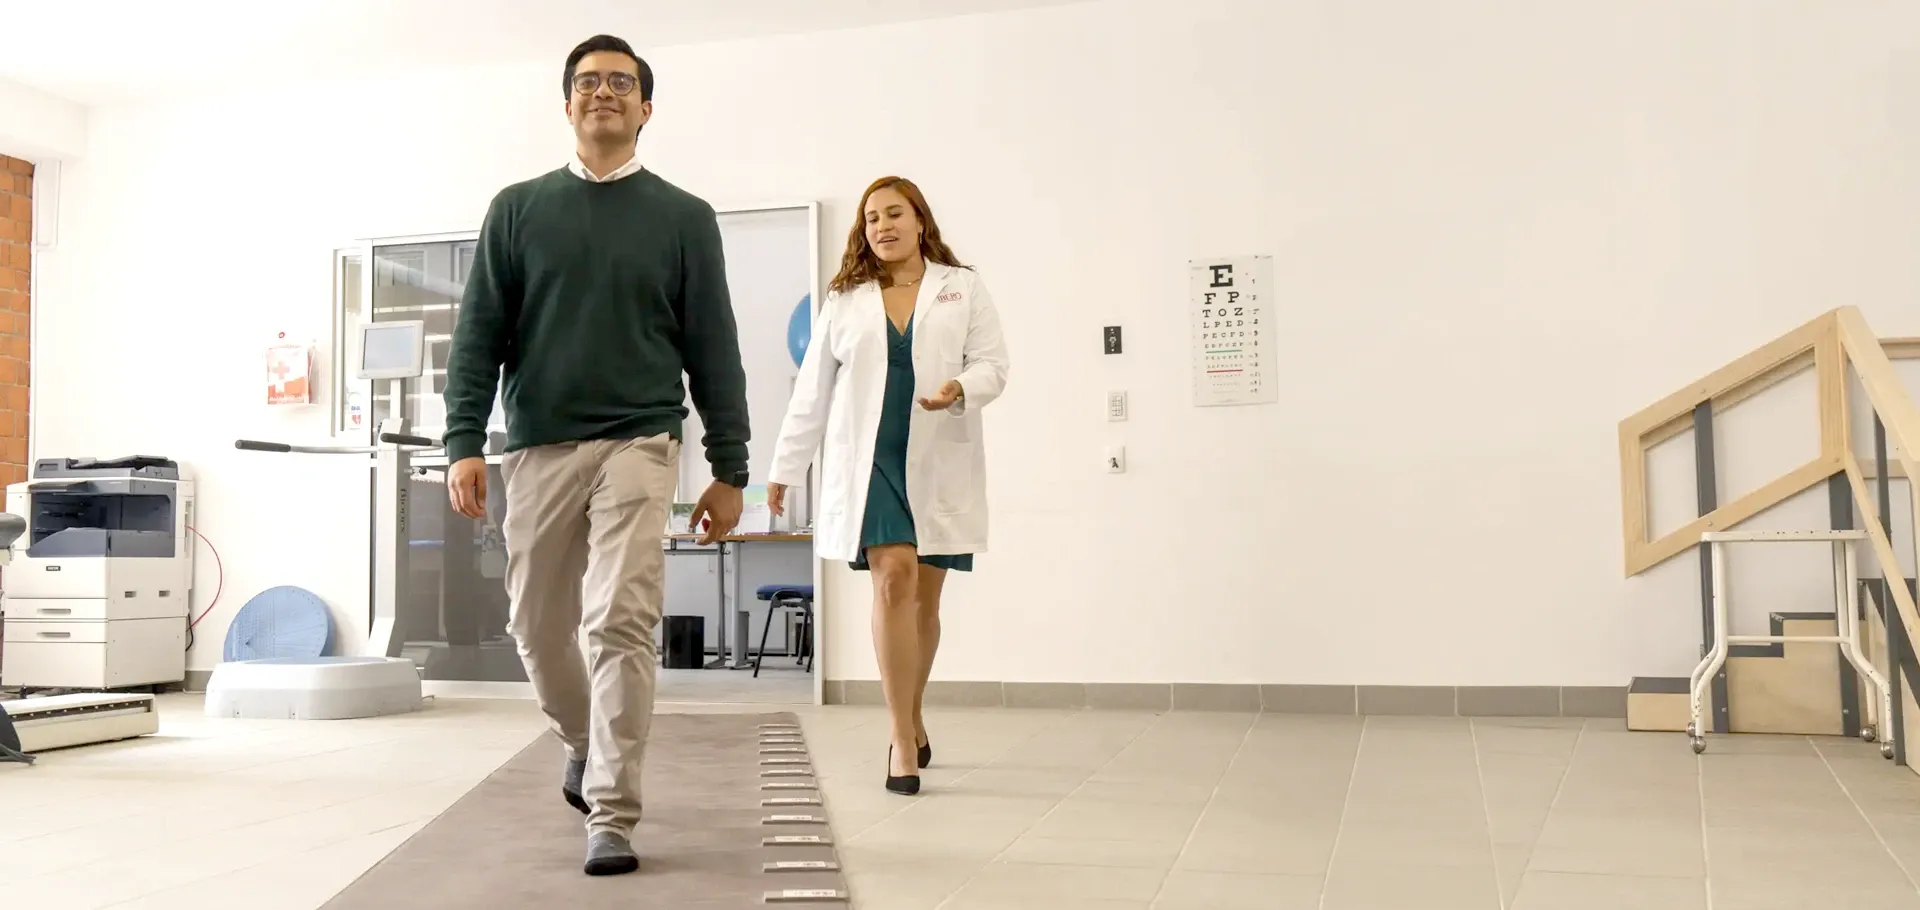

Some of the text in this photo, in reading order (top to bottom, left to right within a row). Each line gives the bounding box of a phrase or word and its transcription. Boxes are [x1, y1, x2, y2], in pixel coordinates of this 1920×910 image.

[1209, 264, 1233, 288] E
[1204, 291, 1239, 305] F P
